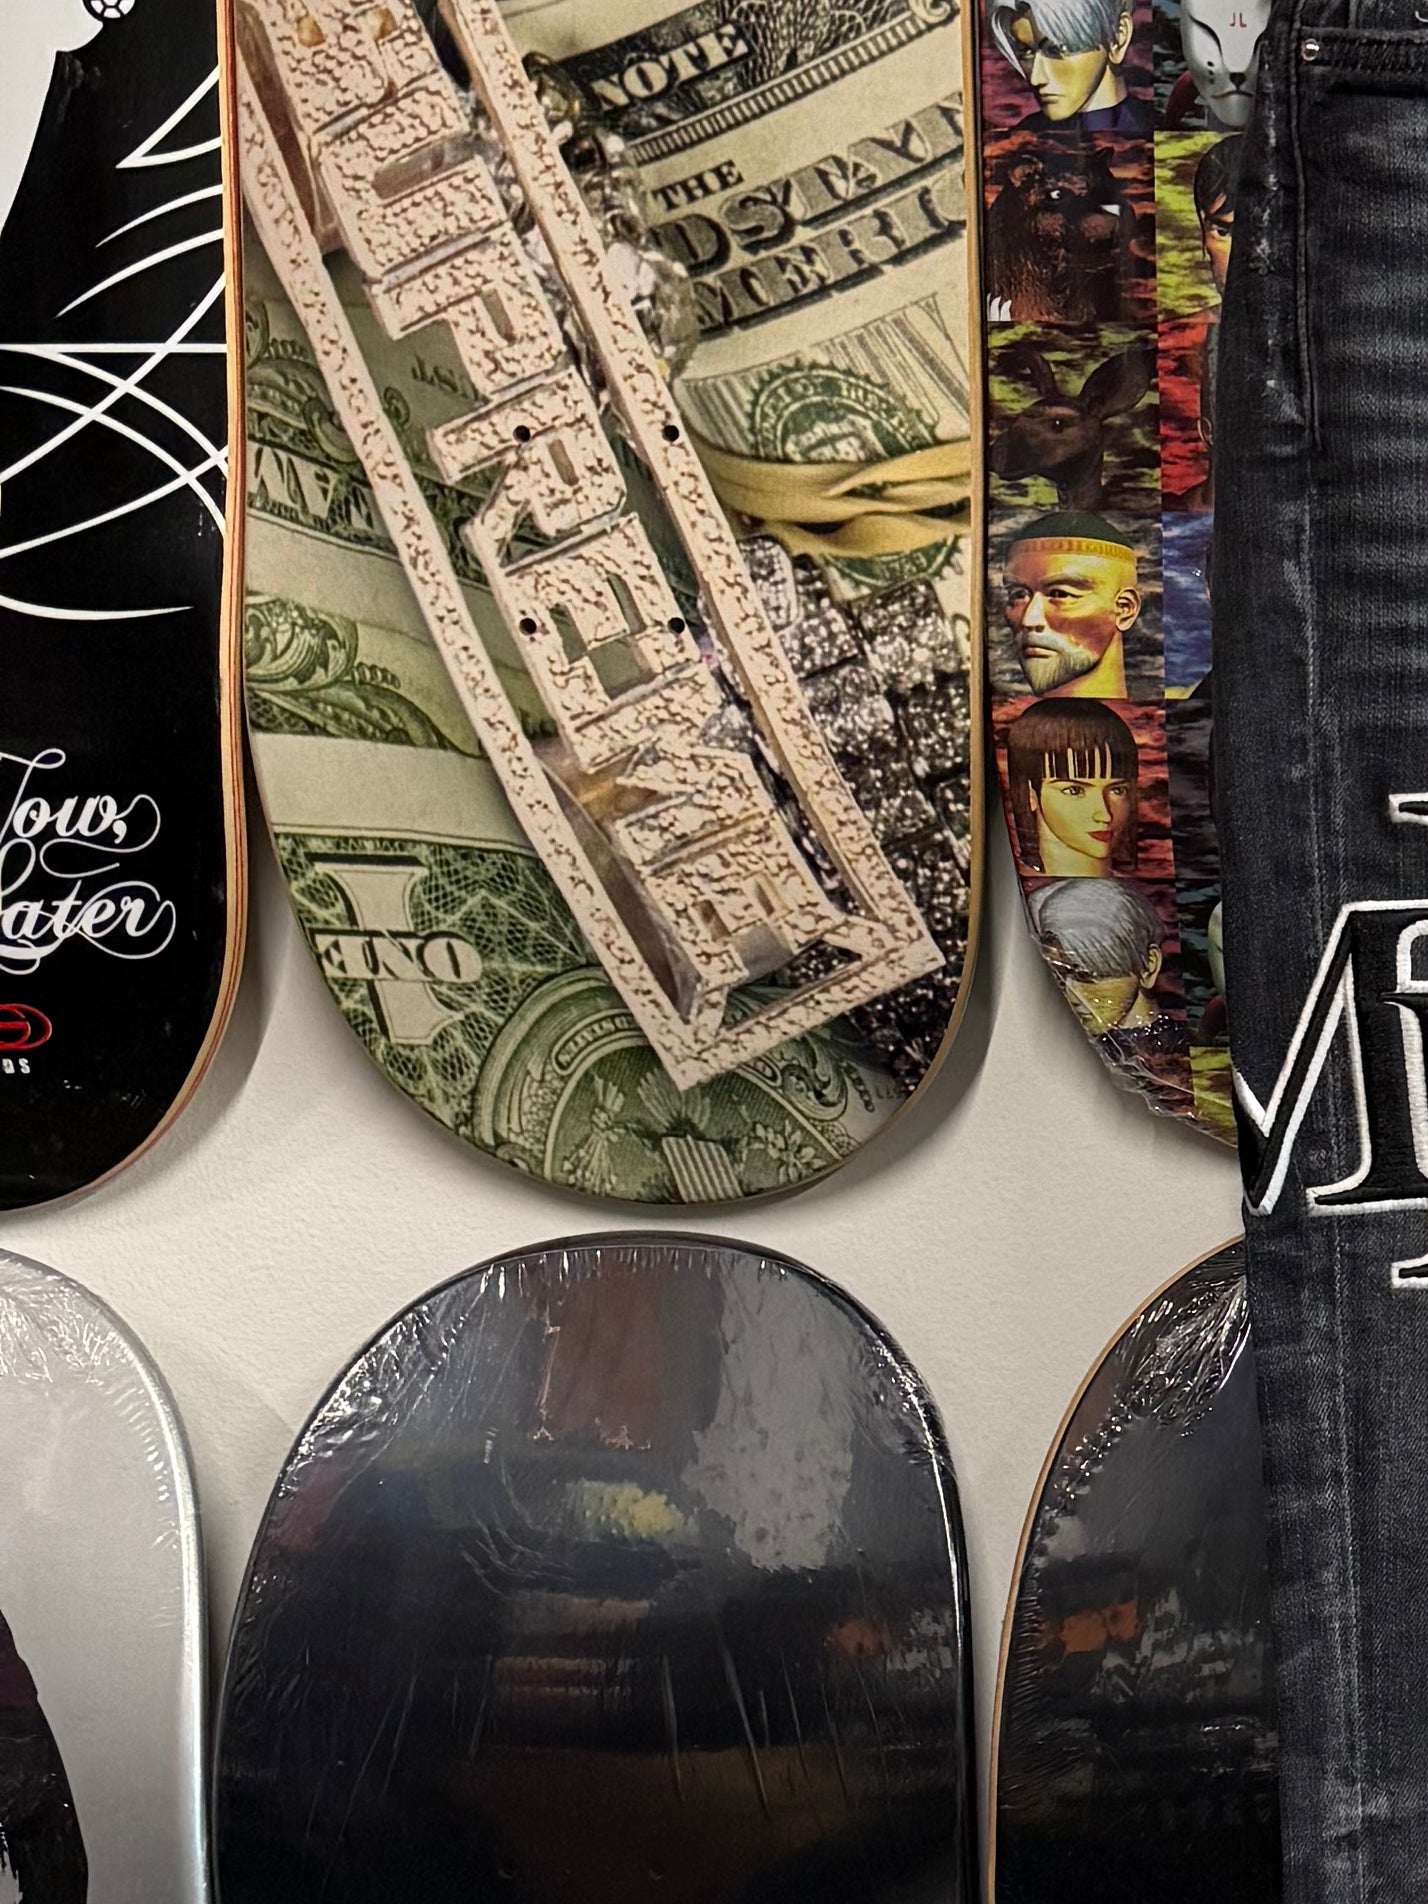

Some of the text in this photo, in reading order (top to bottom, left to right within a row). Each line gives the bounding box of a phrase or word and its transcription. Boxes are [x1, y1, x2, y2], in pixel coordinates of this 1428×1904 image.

[590, 24, 749, 112] NOTE
[652, 159, 744, 212] THE
[318, 928, 483, 985] ONE
